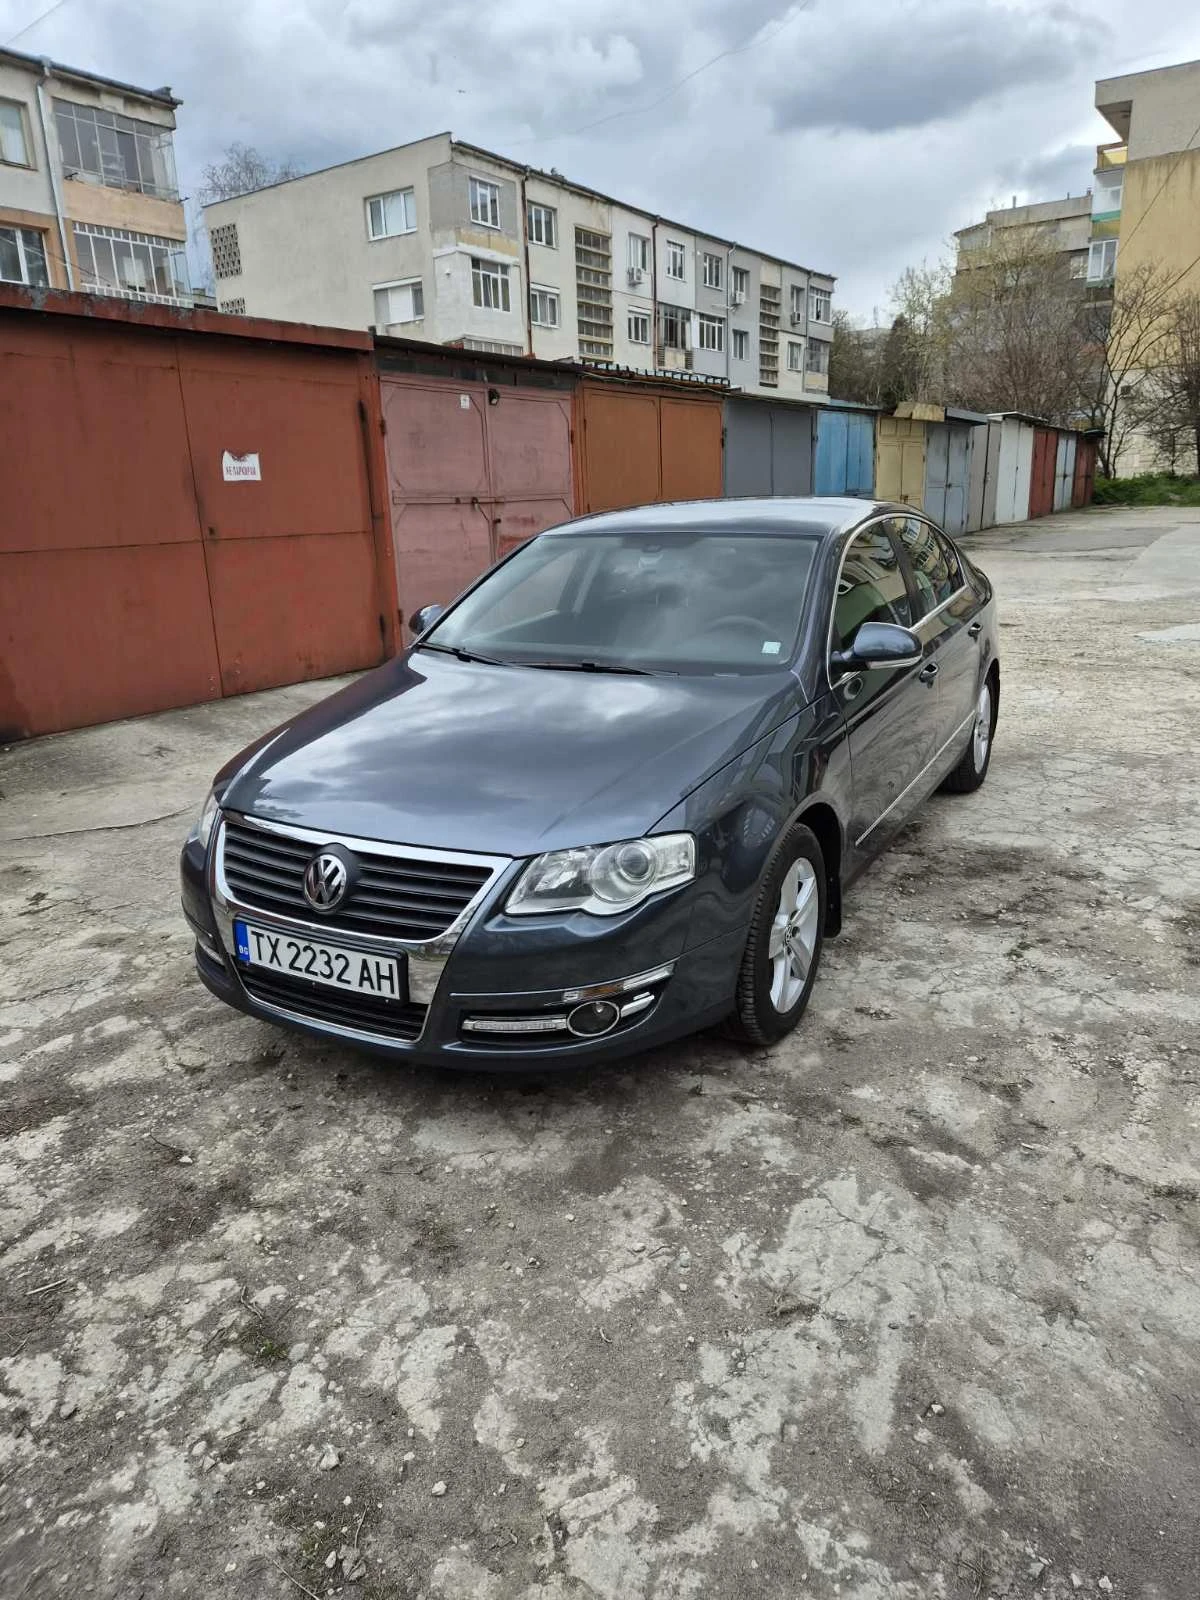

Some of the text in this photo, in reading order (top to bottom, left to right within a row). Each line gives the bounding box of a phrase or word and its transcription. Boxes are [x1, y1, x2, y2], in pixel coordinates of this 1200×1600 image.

[251, 930, 396, 995] TX 2232 AH
